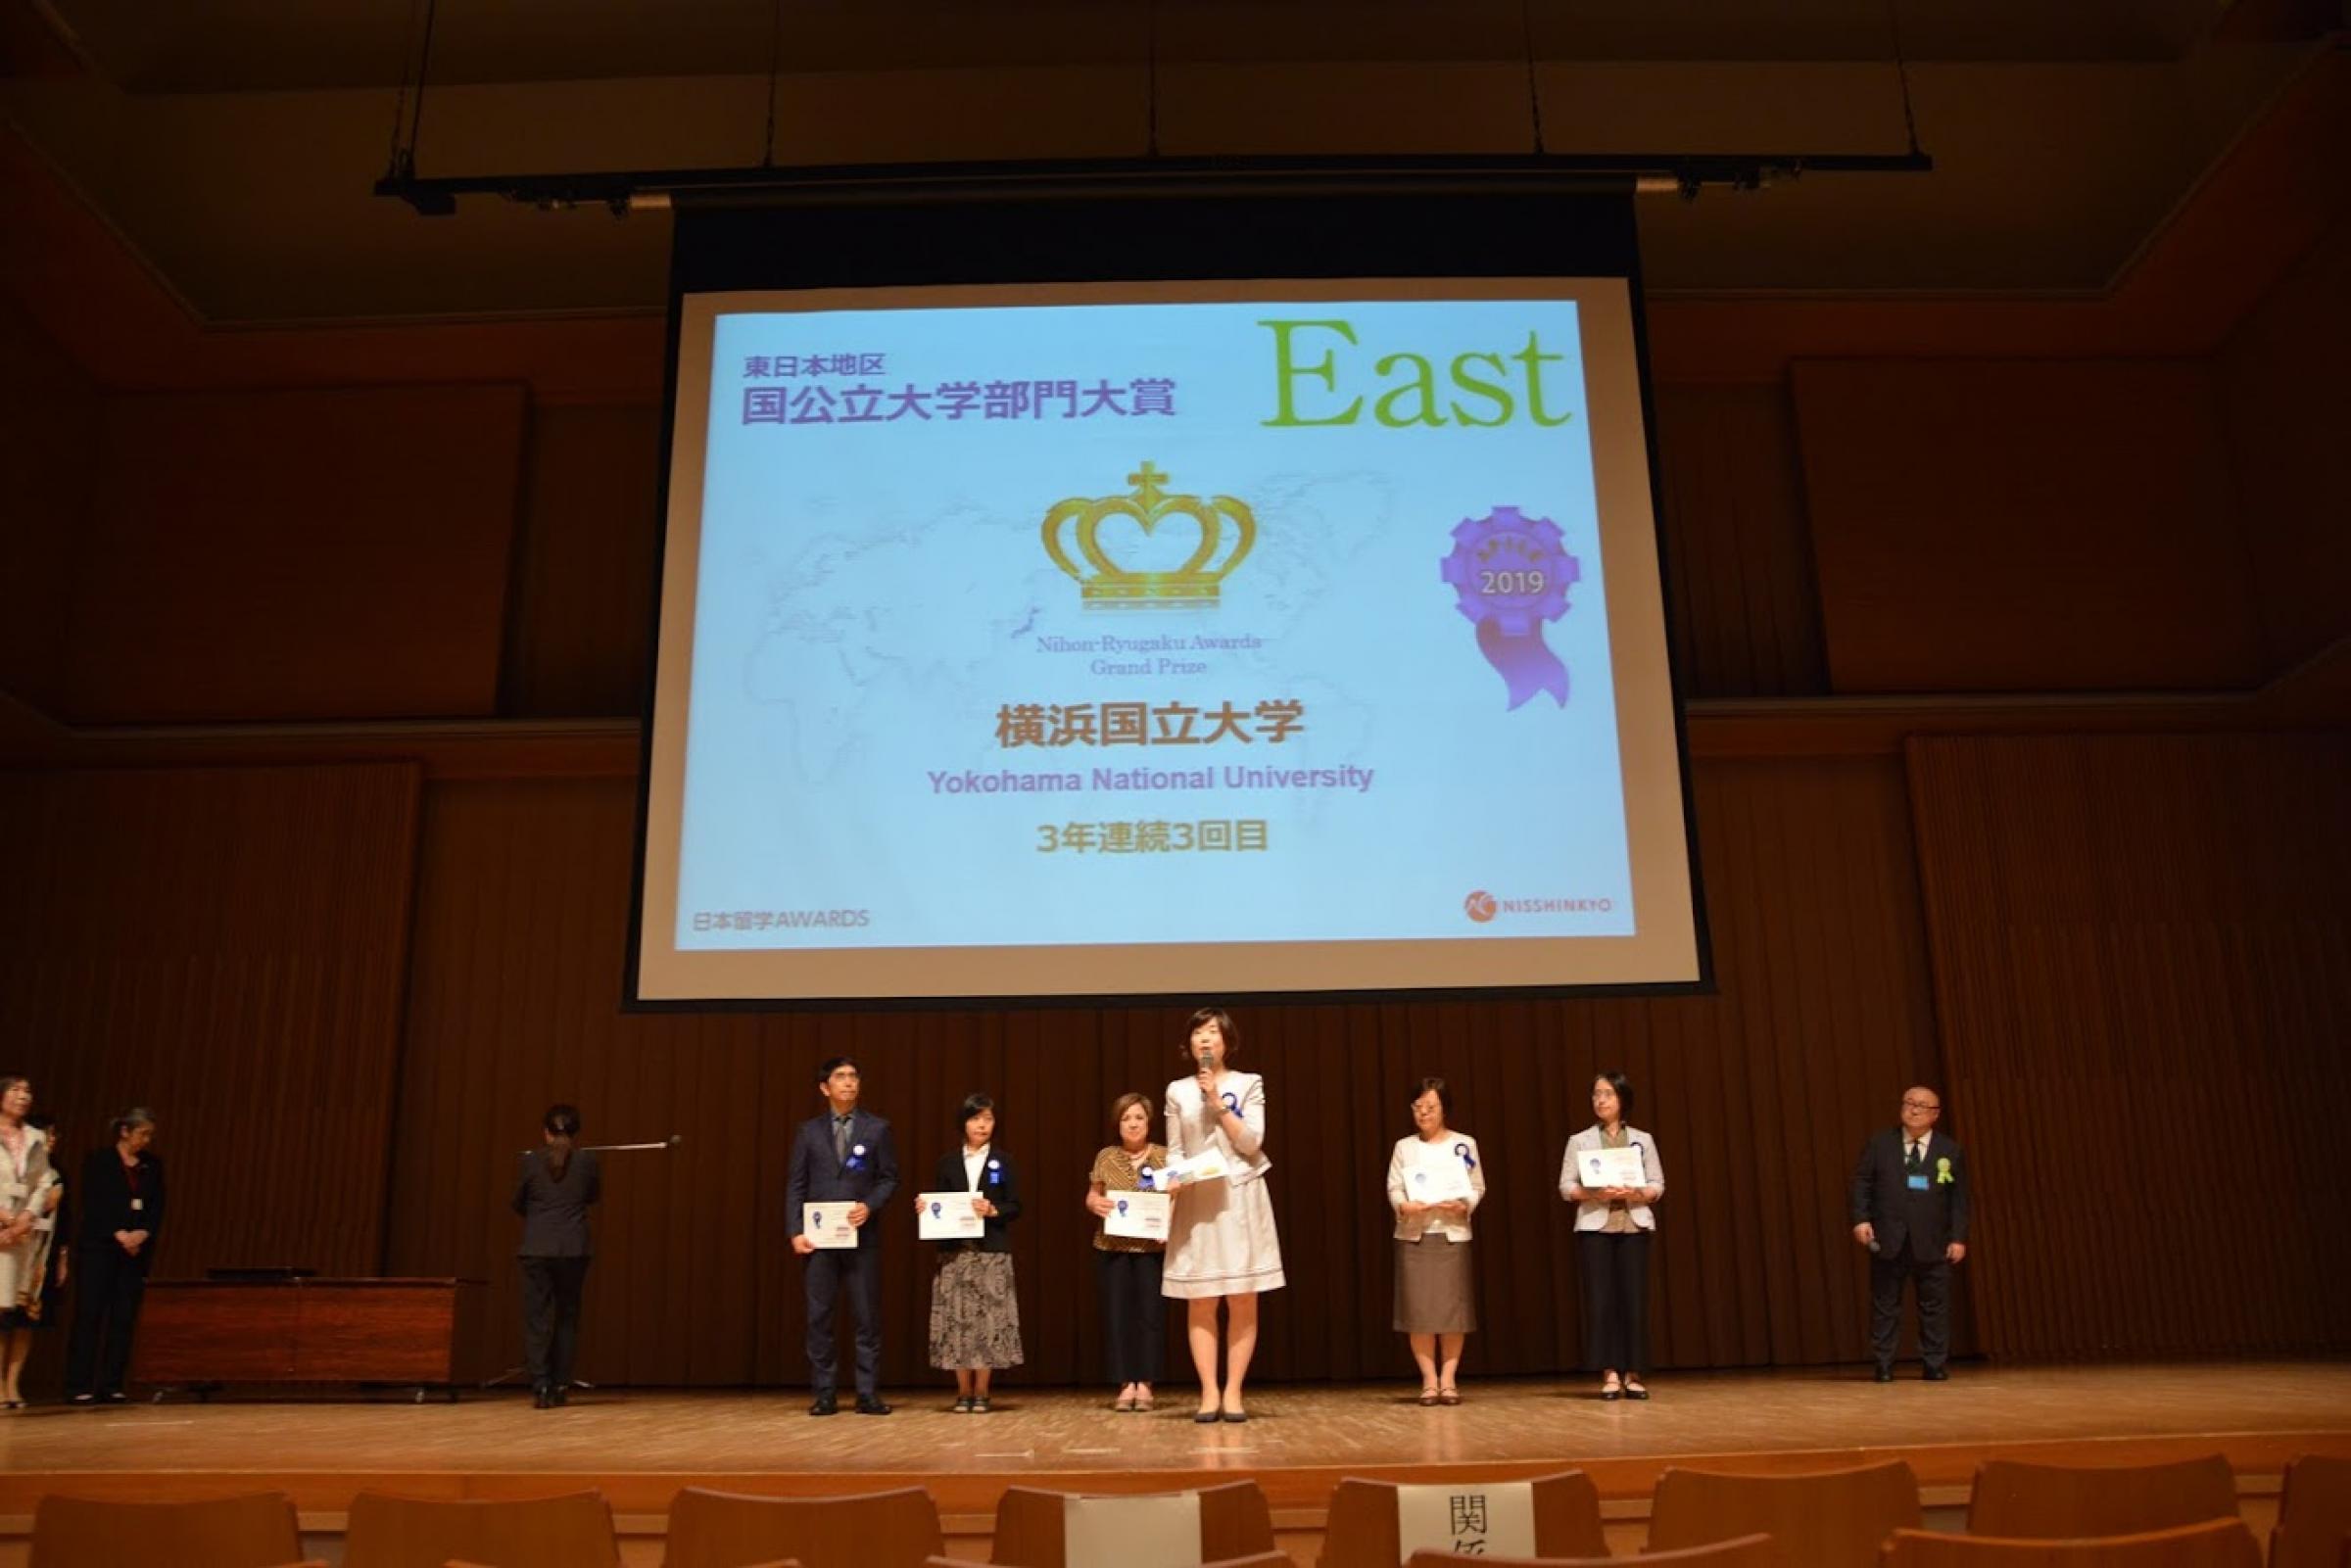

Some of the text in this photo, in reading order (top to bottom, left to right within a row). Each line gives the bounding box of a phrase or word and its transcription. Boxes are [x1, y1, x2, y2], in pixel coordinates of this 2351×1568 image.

[743, 354, 887, 378] 東日本地区
[1256, 320, 1573, 428] East
[742, 377, 1176, 425] 国公立大学部門大賞
[1480, 570, 1545, 595] 2019
[1036, 633, 1262, 654] Nihon-Ryugaku Awards
[1090, 657, 1208, 675] Grand Prize
[995, 699, 1305, 747] 横浜国立大学
[927, 765, 1374, 793] Yokohama National University
[1035, 819, 1269, 853] 3年連続3回目
[1503, 898, 1611, 913] NISSHINKYO
